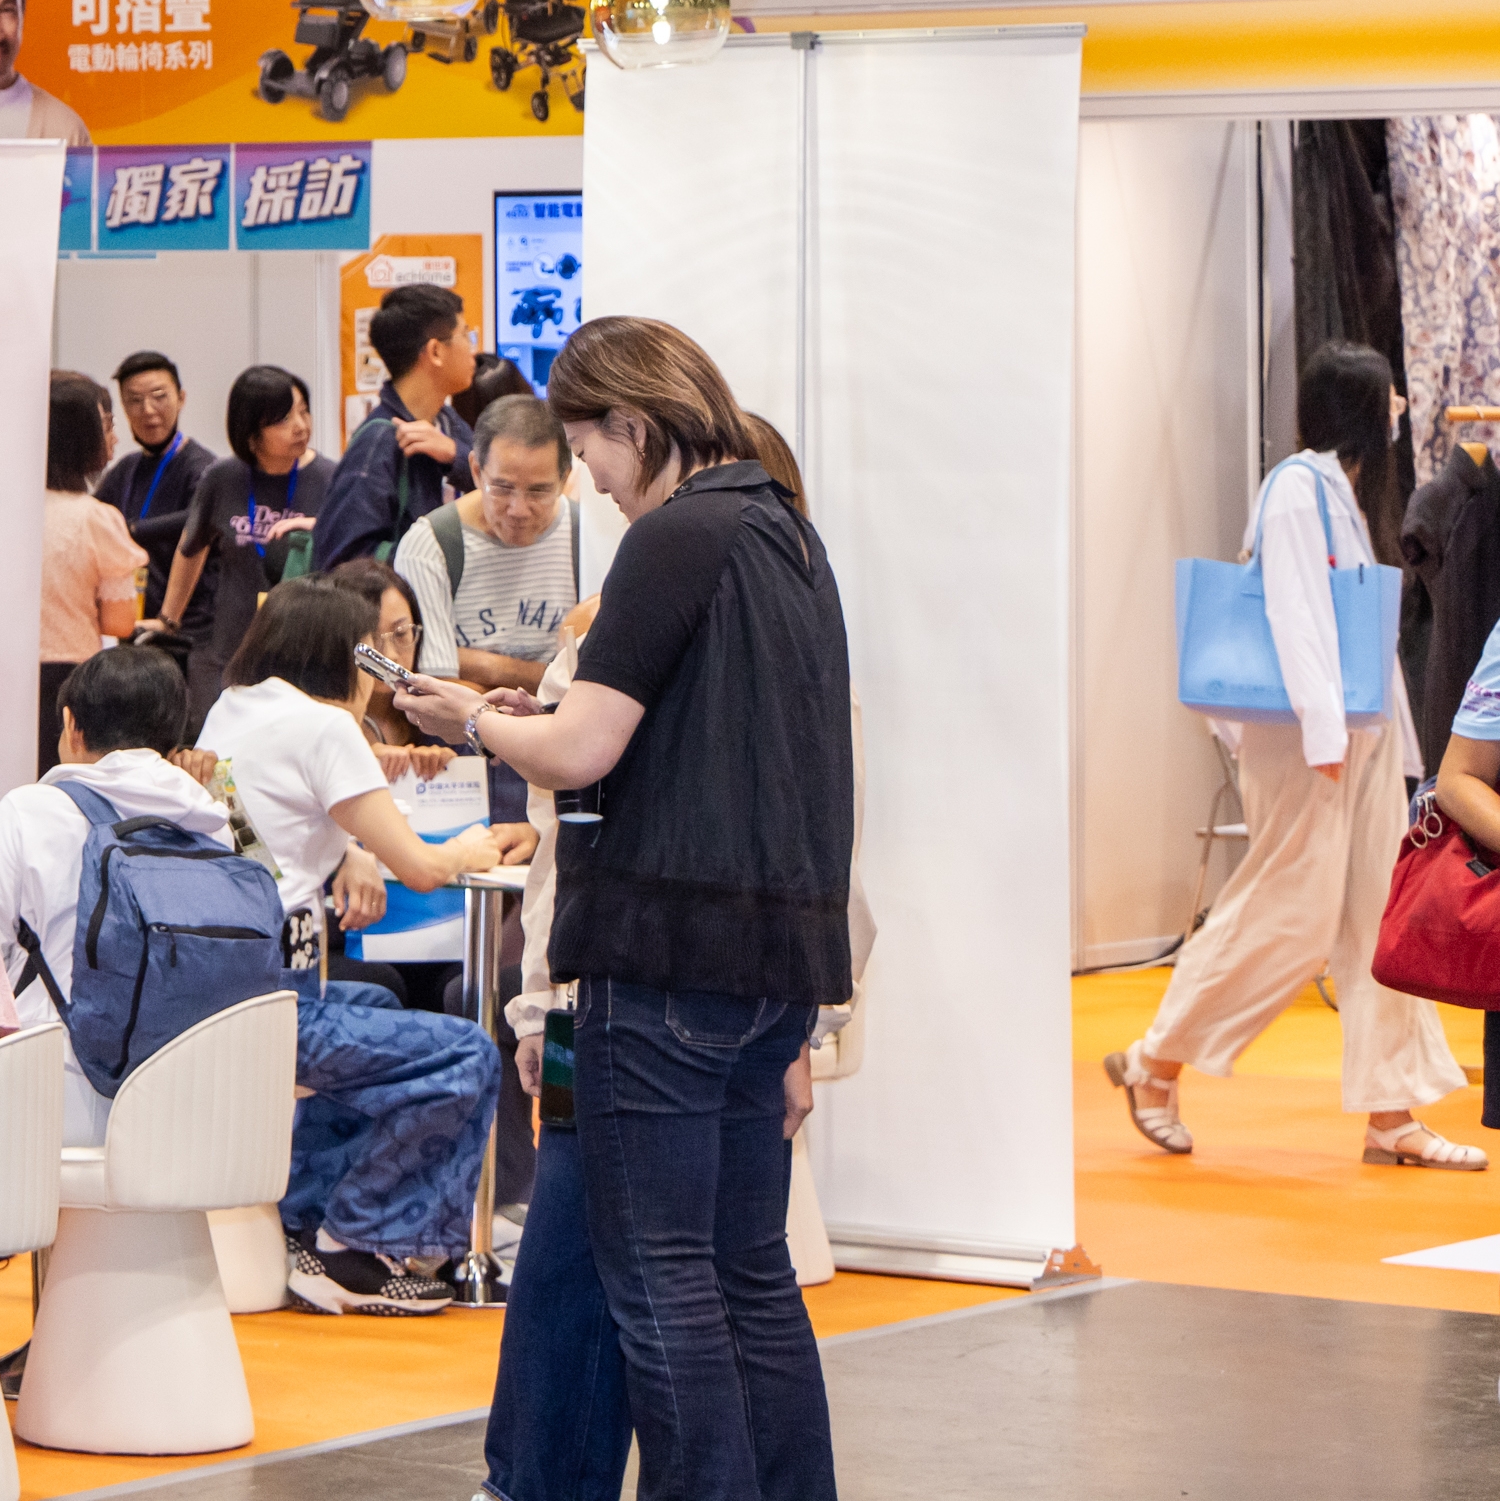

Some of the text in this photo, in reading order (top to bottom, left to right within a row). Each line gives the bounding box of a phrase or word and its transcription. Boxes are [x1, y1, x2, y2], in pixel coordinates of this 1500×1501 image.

[67, 39, 214, 73] 電動輪椅系列
[104, 153, 363, 229] 獨家 採訪
